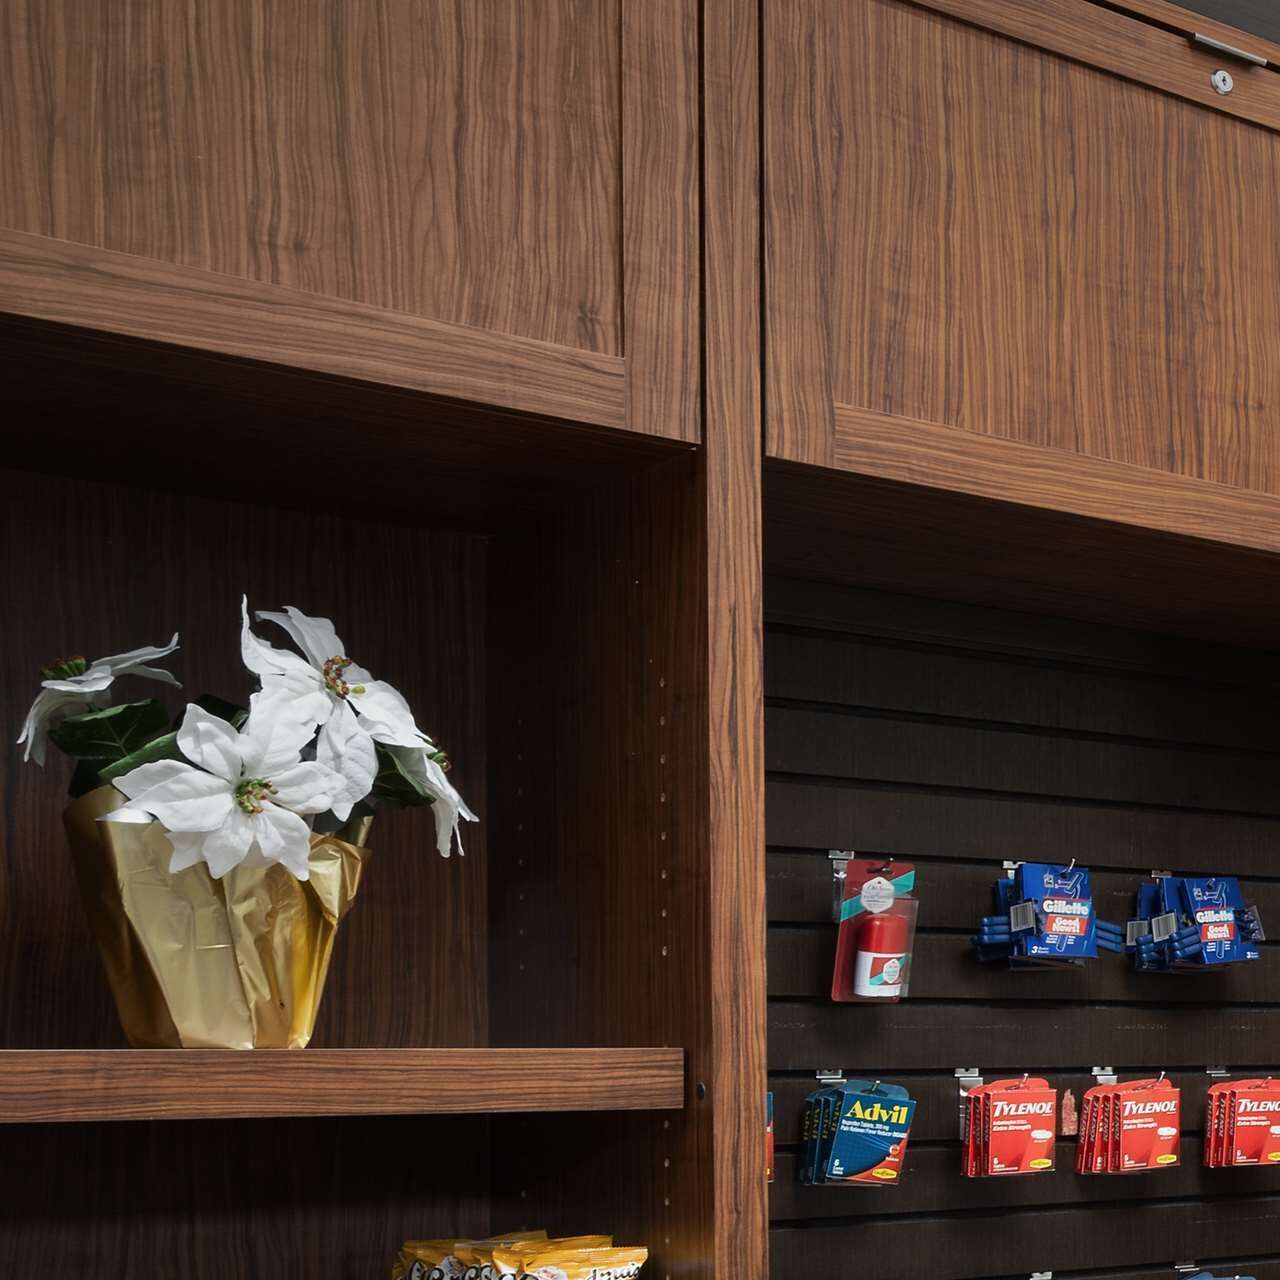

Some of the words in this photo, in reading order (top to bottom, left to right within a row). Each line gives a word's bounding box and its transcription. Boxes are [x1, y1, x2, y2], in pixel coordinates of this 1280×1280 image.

[1043, 899, 1089, 915] Gillette
[1054, 917, 1080, 926] Good
[1197, 911, 1234, 924] Gillette
[1207, 924, 1228, 933] Good
[844, 1100, 908, 1125] Advil
[993, 1102, 1052, 1117] TYLENOL
[1122, 1101, 1176, 1116] TYLENOL
